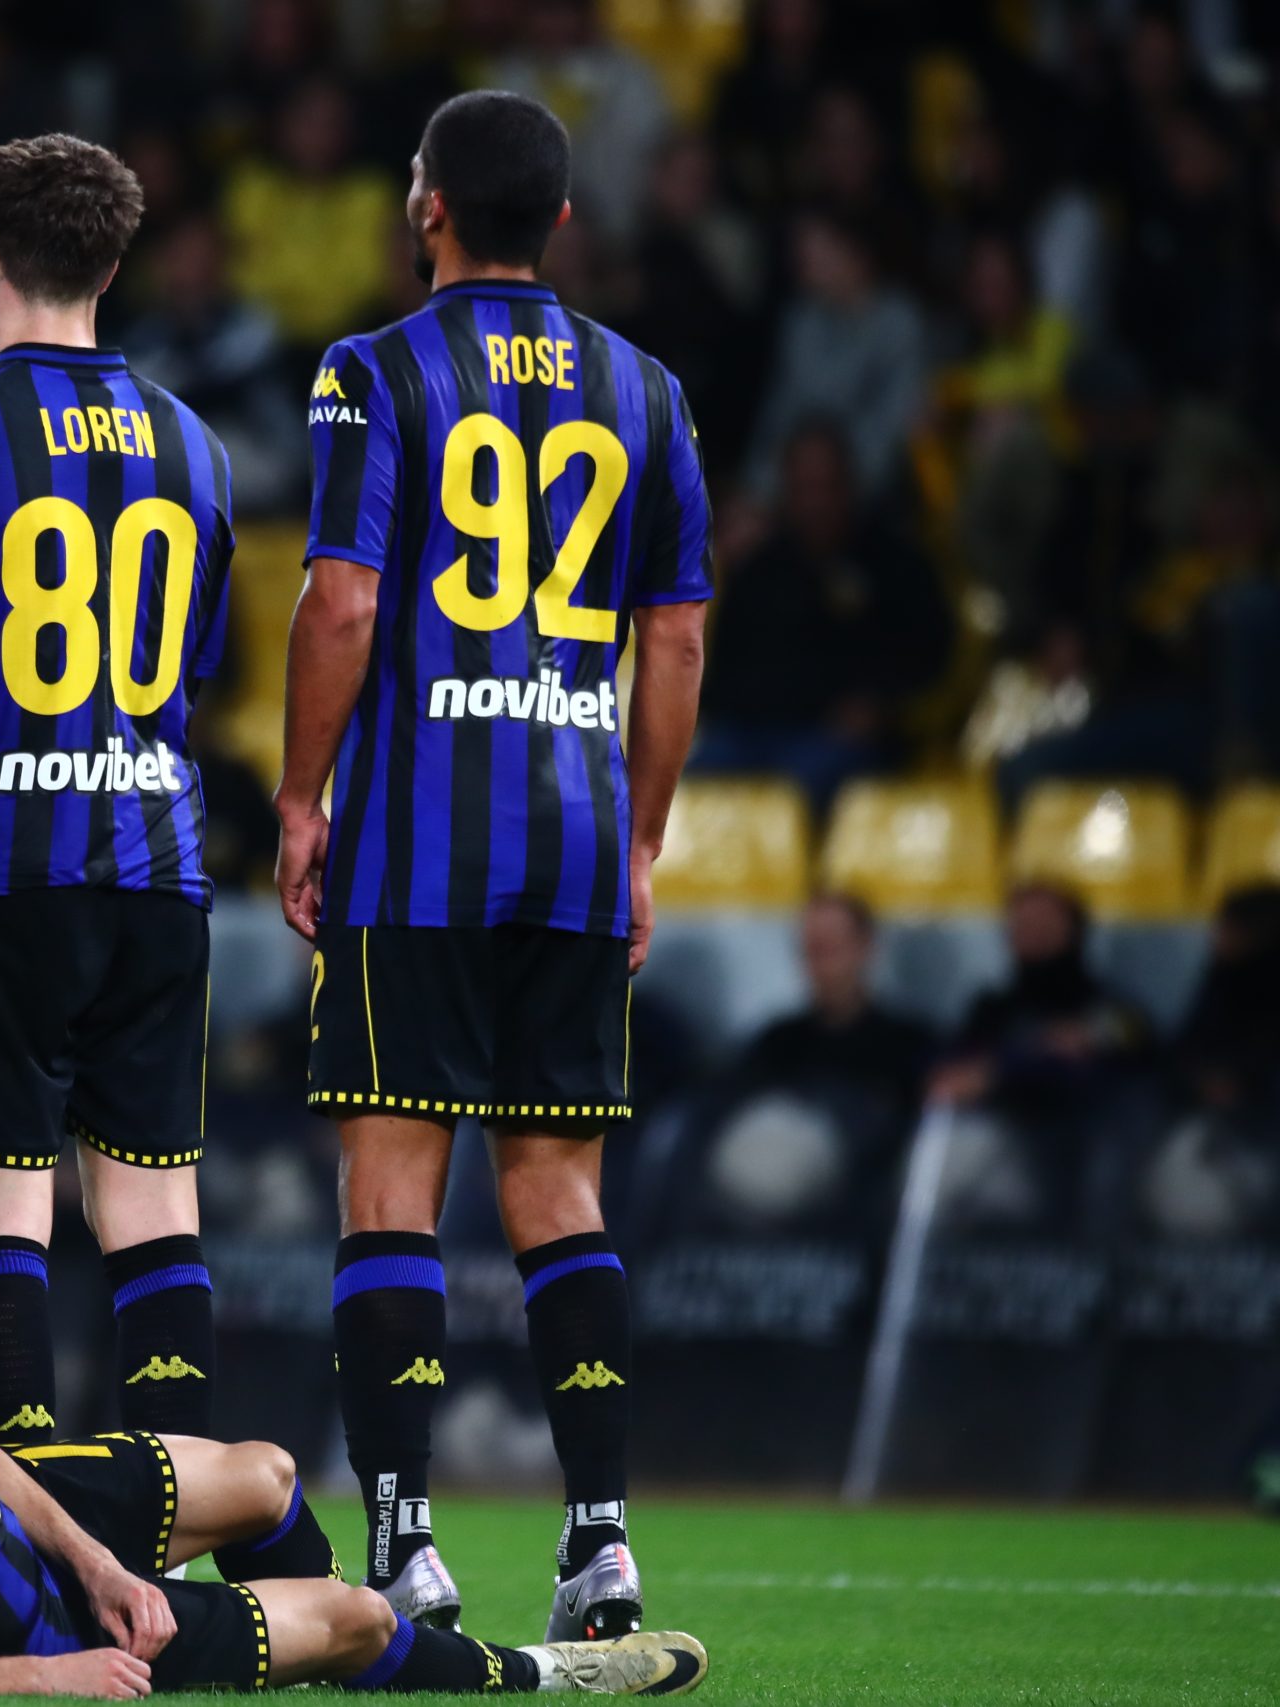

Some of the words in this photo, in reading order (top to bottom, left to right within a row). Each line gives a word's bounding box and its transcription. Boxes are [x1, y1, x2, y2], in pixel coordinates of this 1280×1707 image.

[486, 334, 575, 390] ROSE
[40, 406, 156, 459] LOREN
[432, 412, 629, 643] 92
[1, 496, 197, 716] 80
[429, 668, 616, 731] novibet
[375, 1501, 393, 1577] TAPEDESIGN
